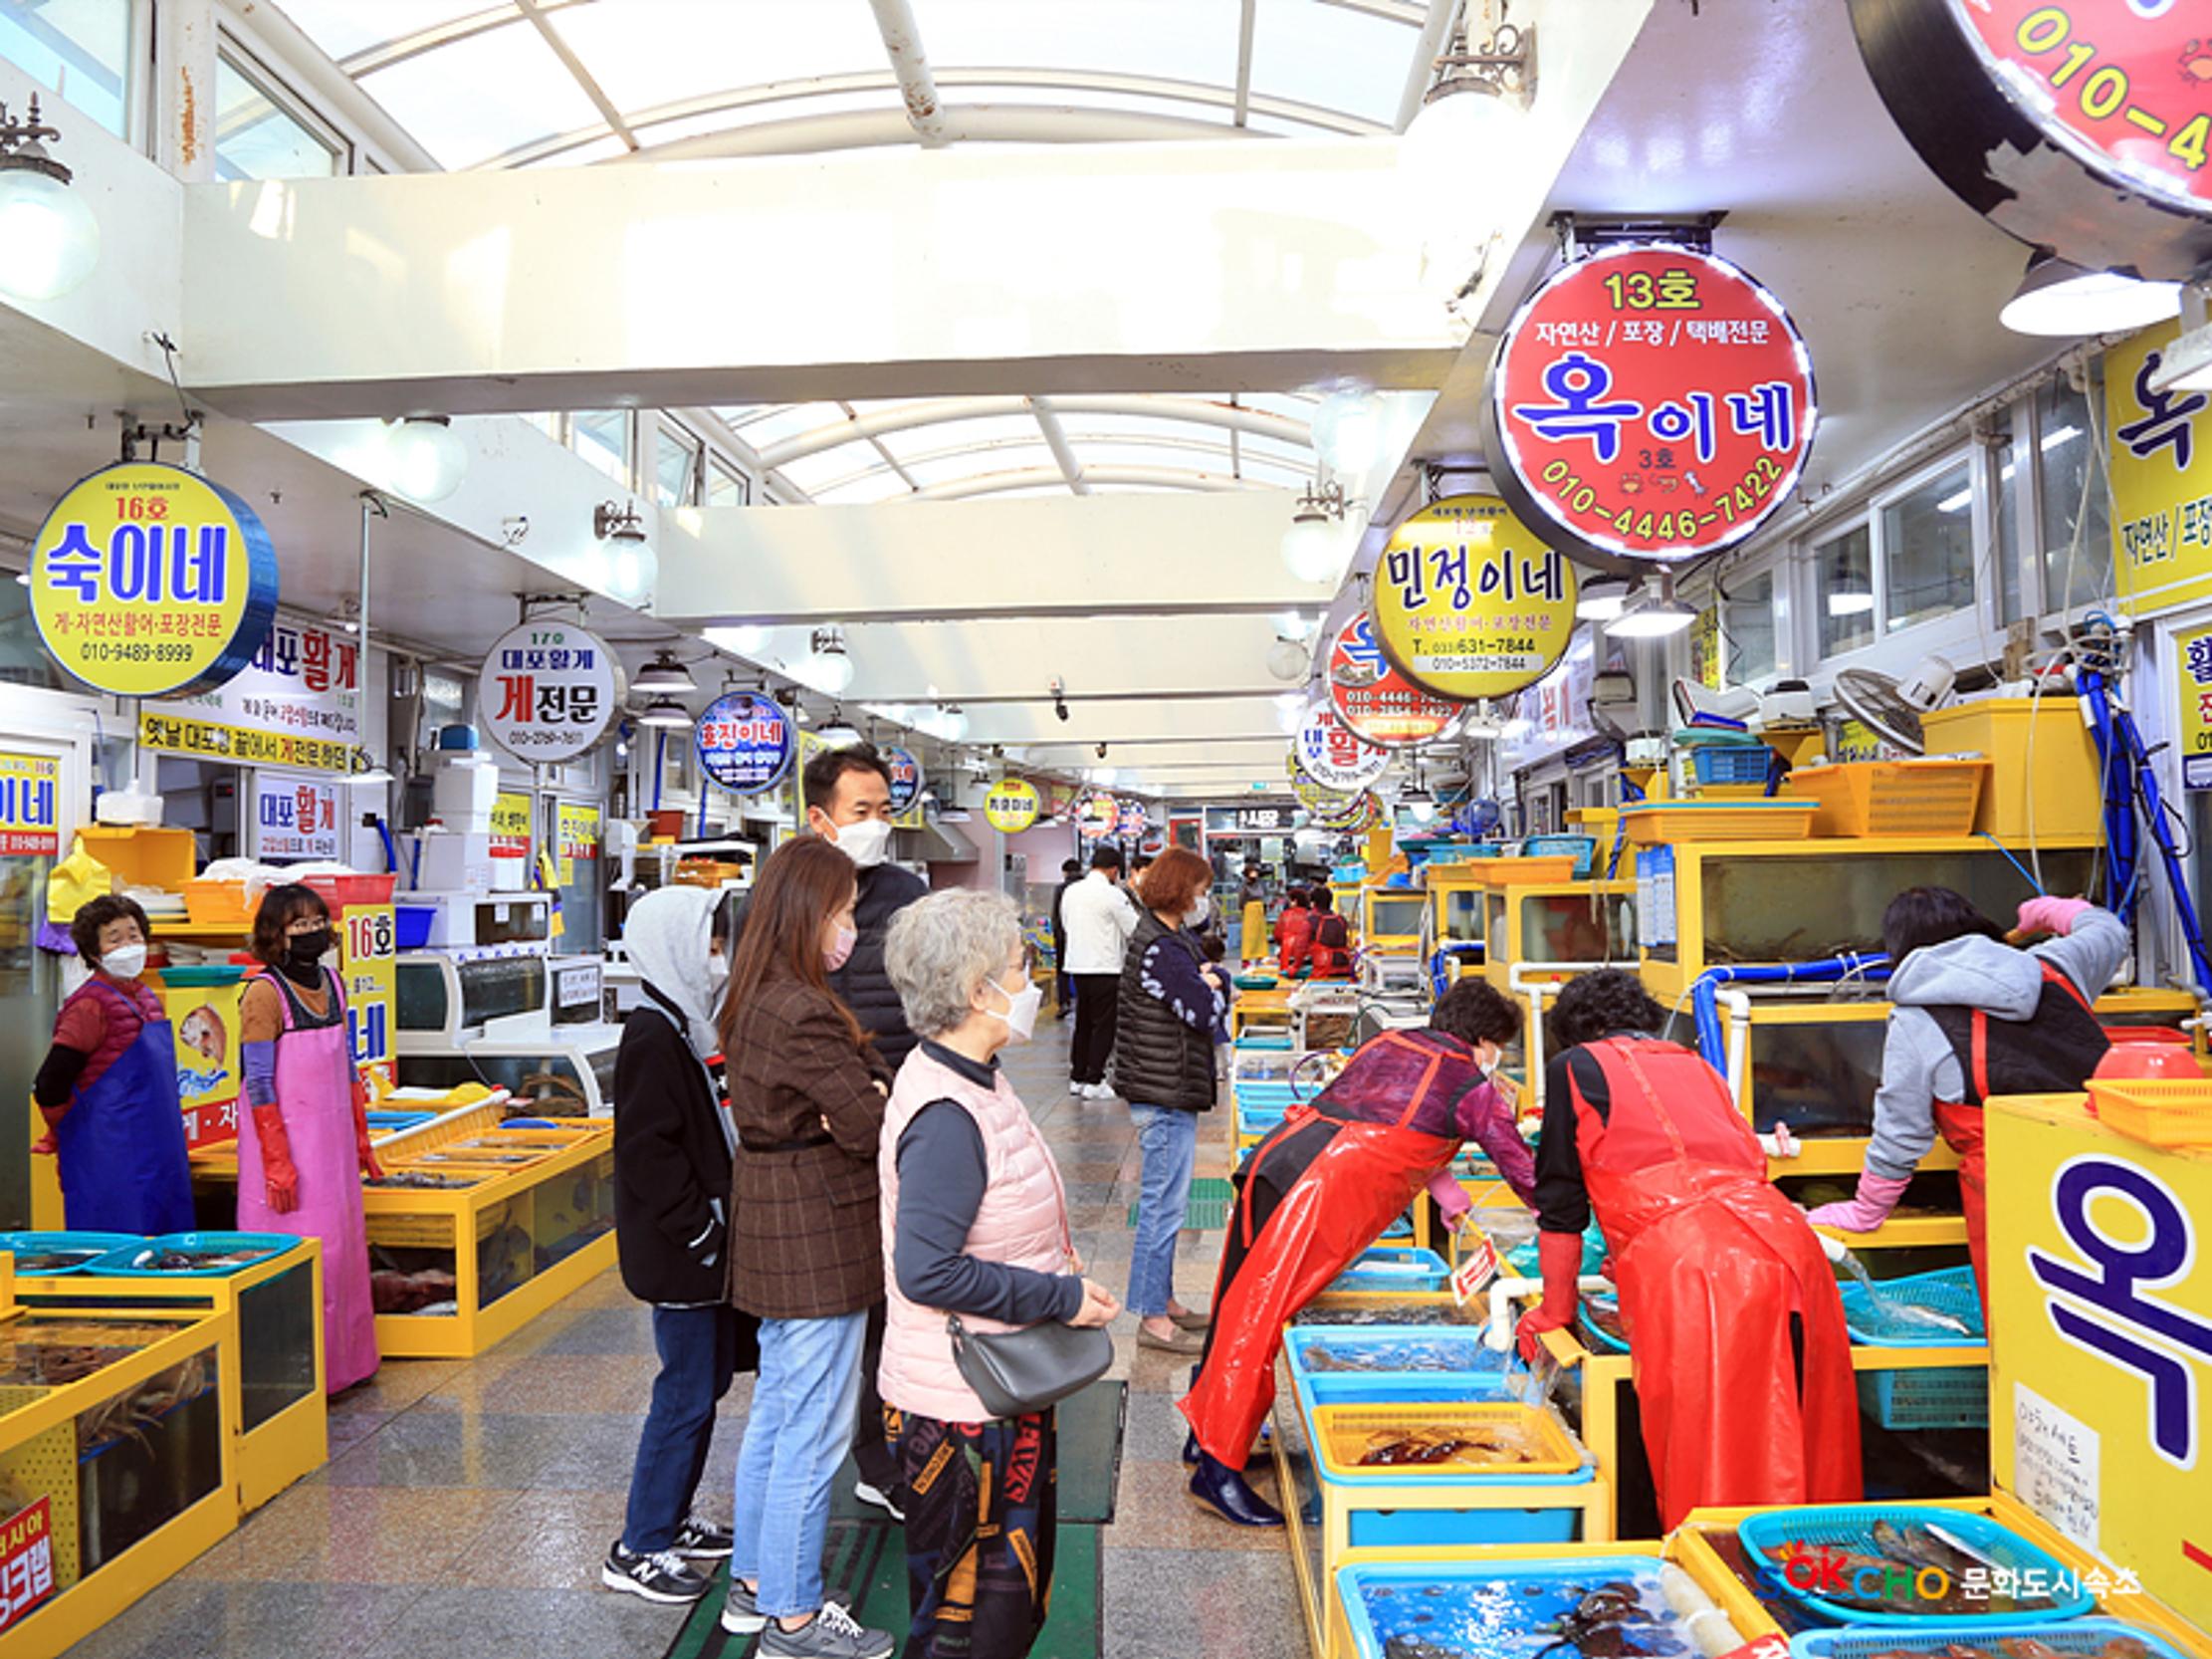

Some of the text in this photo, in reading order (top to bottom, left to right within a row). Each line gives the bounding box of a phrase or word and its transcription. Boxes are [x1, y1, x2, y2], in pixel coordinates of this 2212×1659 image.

[1604, 269, 1701, 310] 13호
[1535, 321, 1600, 348] 자연산
[1623, 321, 1664, 347] 포장
[1686, 320, 1769, 346] 택배전문
[1512, 353, 1794, 464] 옥이네
[115, 496, 169, 521] 16호
[1541, 456, 1784, 542] 010-4446-7422
[46, 524, 228, 603] 숙이네
[1386, 543, 1565, 610] 민정이네
[81, 641, 193, 663] 010-9489-8999
[494, 673, 599, 725] 게전문
[348, 915, 392, 959] 16호
[2030, 1160, 2212, 1462] 옥
